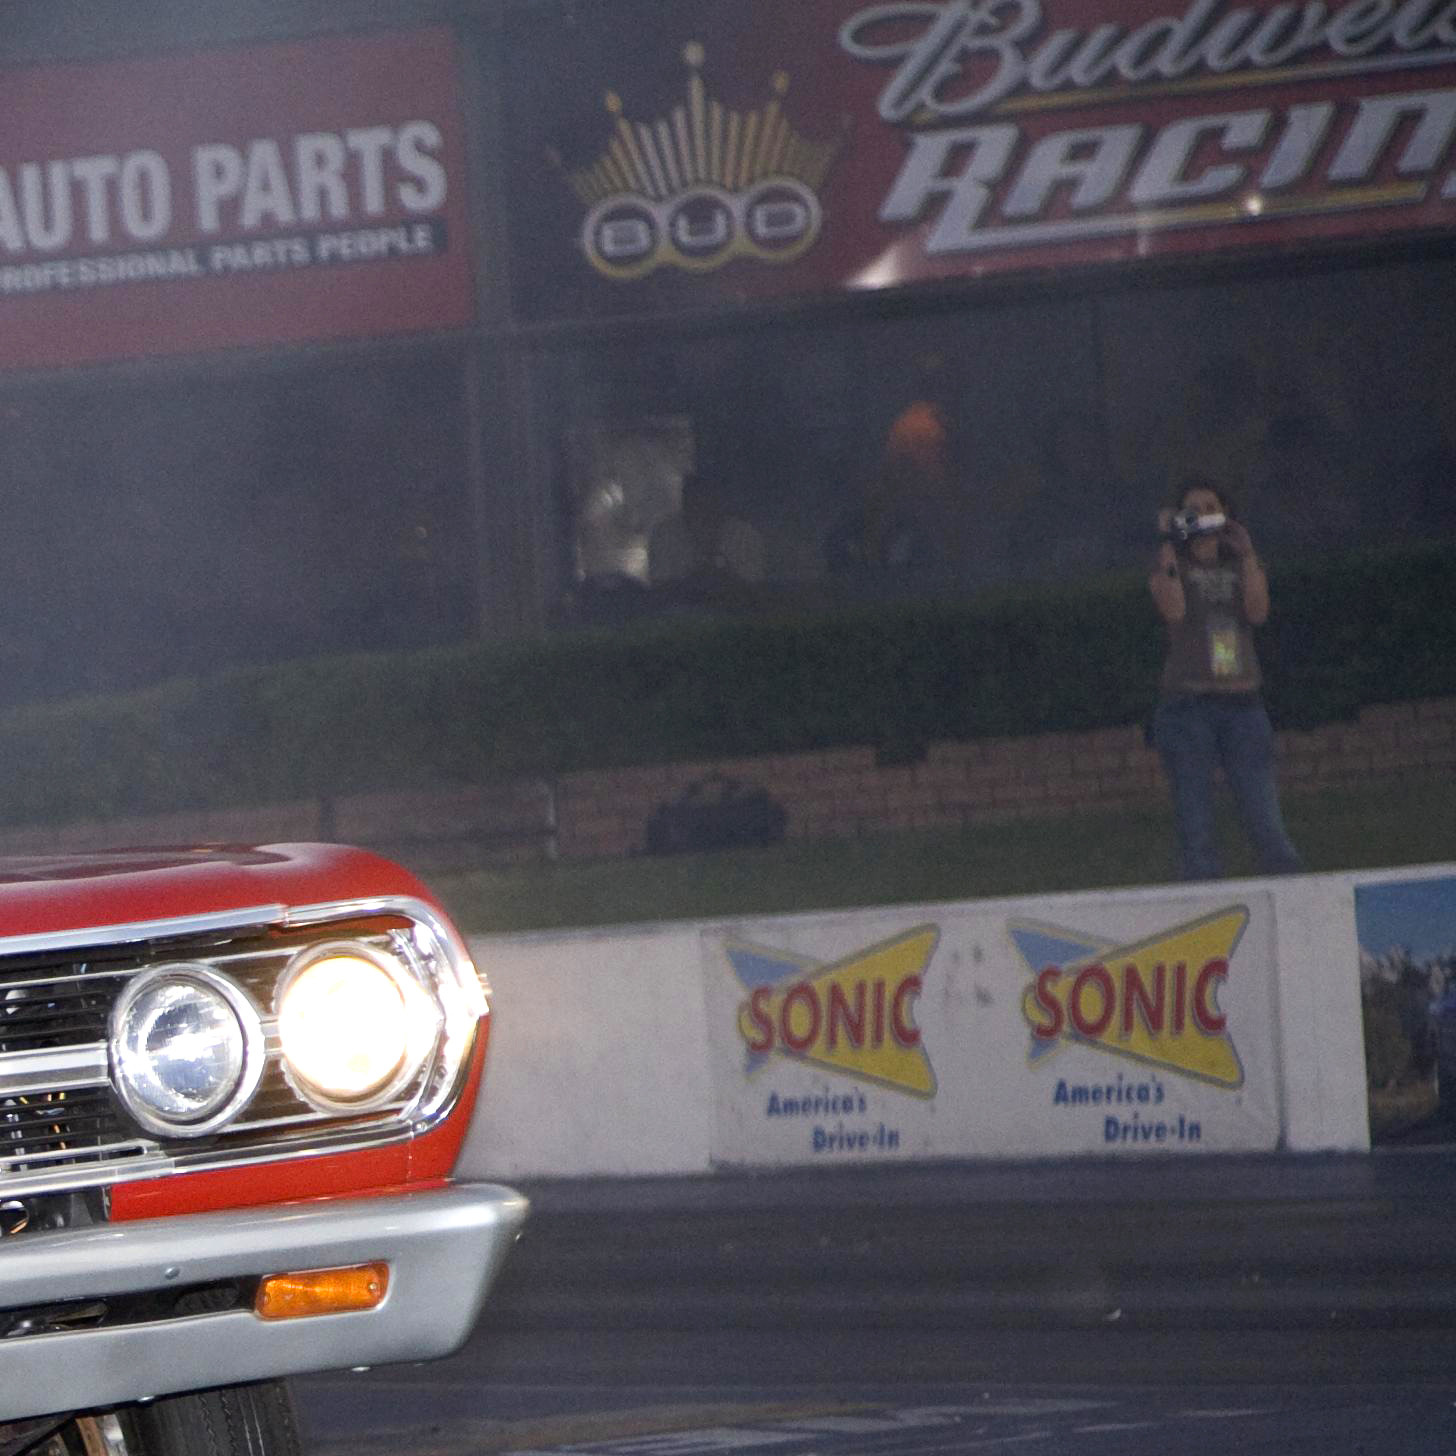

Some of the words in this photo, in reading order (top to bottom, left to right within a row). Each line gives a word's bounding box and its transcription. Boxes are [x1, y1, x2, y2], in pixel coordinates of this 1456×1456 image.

[190, 119, 448, 234] PARTS
[878, 88, 1456, 256] RACIN
[209, 235, 311, 274] PARTS
[318, 222, 434, 262] PEOPLE
[598, 196, 808, 256] BUD
[746, 976, 923, 1054] SONIC
[1033, 956, 1230, 1042] SONIC
[767, 1086, 868, 1119] America's
[1052, 1080, 1166, 1109] America's
[811, 1122, 901, 1152] Drive-In
[1103, 1112, 1203, 1145] Drive-In
